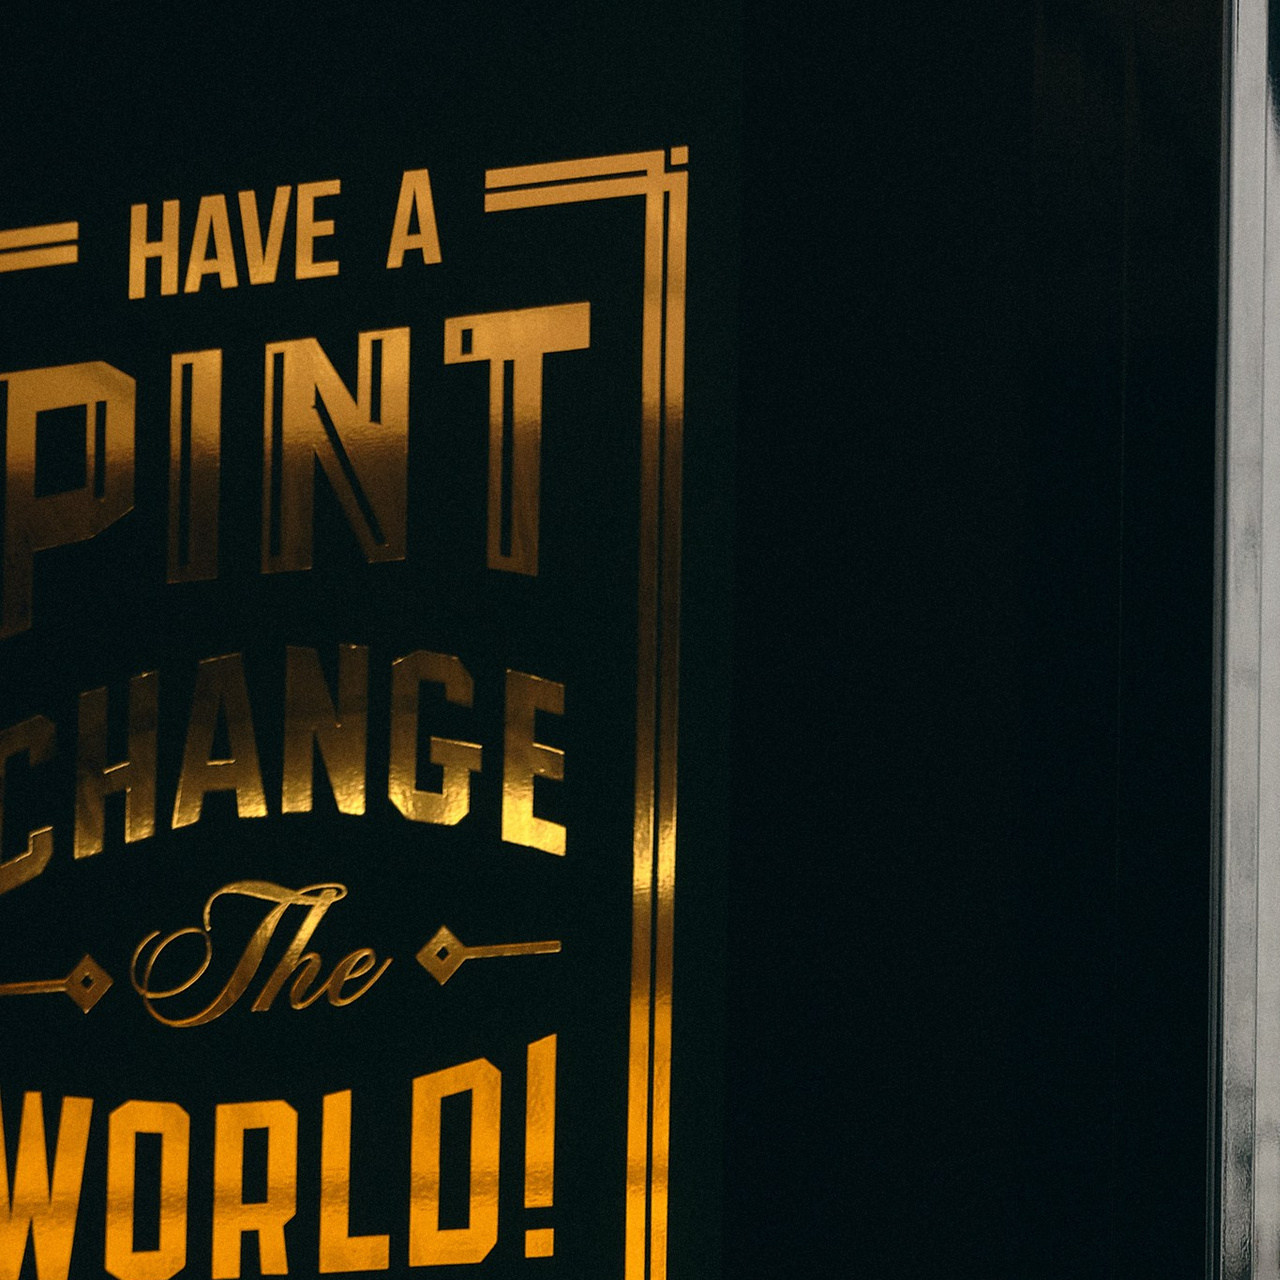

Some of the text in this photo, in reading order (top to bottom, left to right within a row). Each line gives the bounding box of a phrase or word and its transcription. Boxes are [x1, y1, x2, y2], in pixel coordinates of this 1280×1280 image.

[127, 167, 443, 301] HAVE A
[0, 300, 592, 642] PINT
[0, 642, 568, 898] CHANGE
[130, 879, 395, 1029] The
